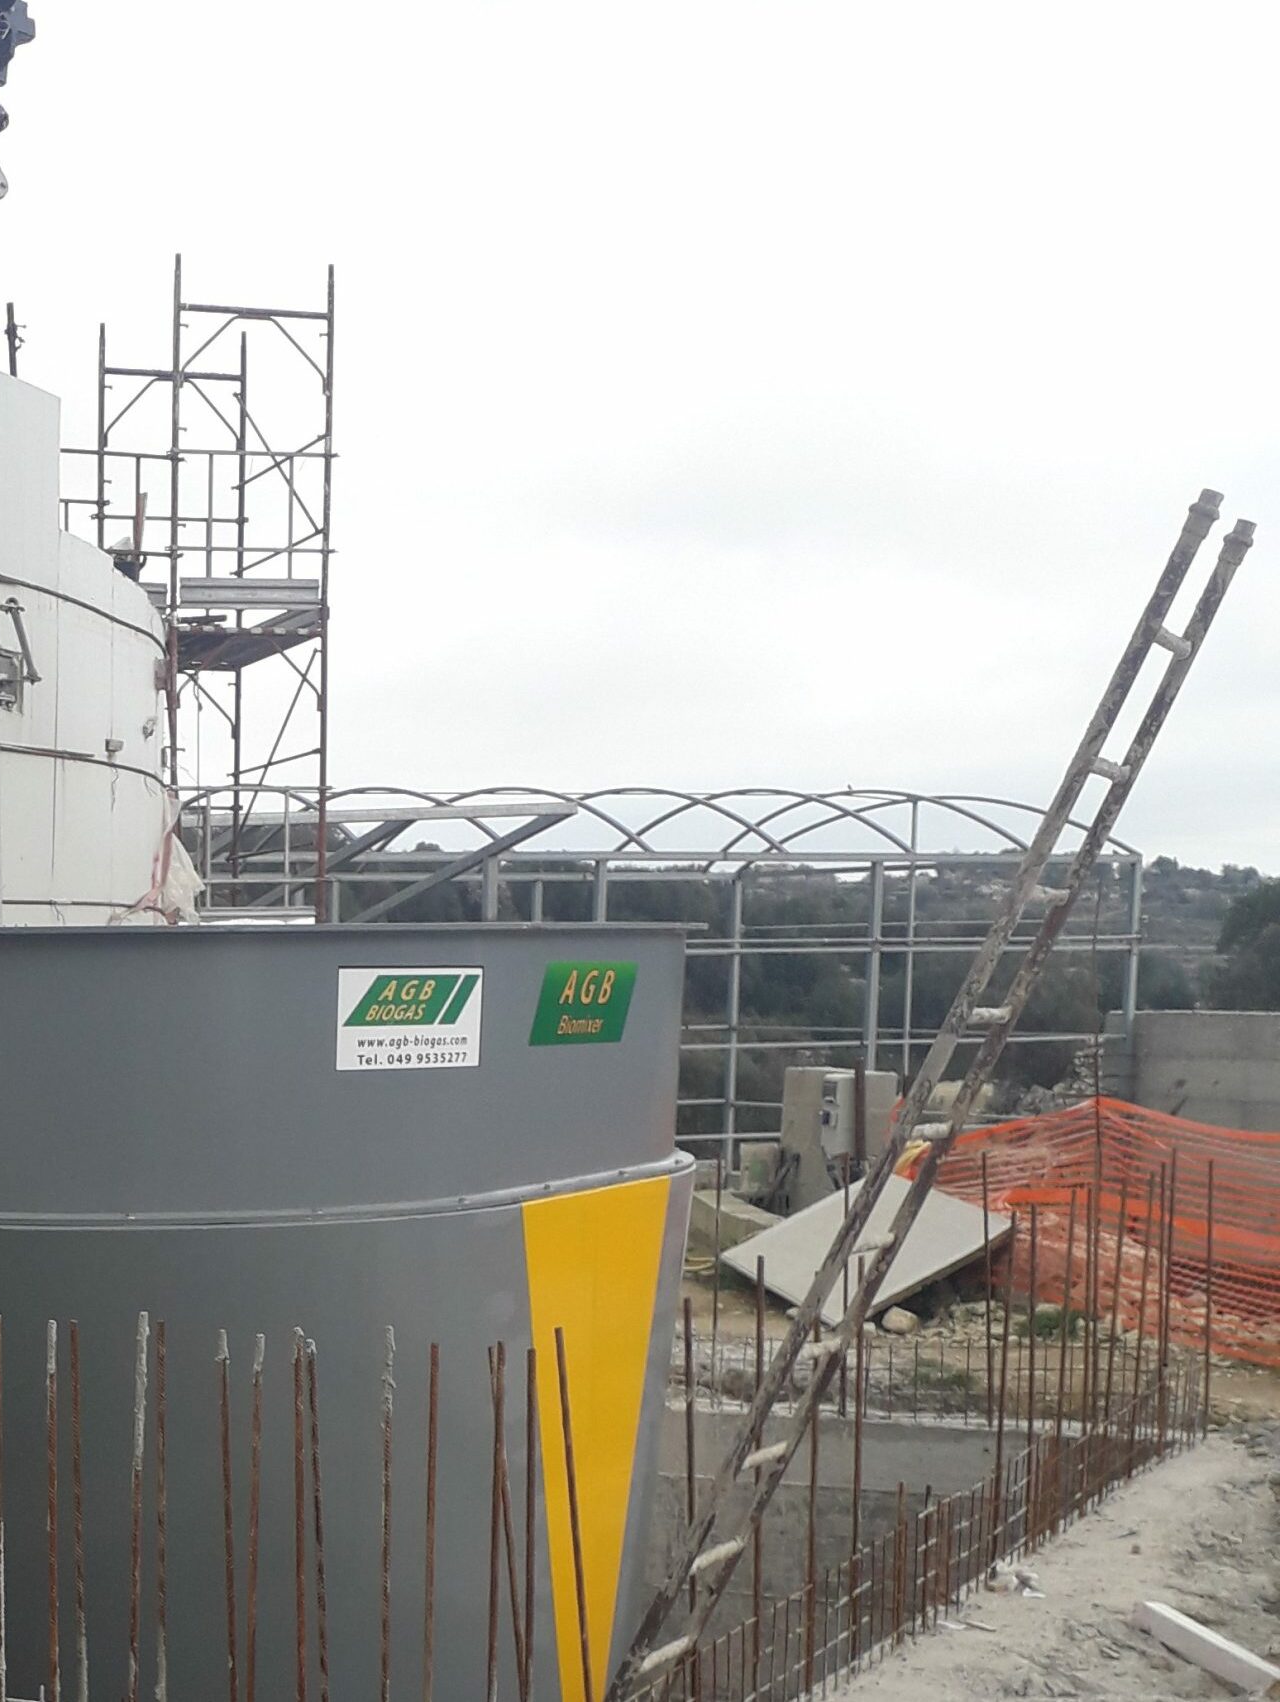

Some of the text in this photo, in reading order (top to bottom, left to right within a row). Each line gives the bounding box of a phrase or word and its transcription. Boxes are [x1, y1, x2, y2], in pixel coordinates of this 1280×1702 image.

[377, 979, 437, 1001] AGB
[558, 969, 616, 1005] AGB
[365, 1004, 426, 1021] BIOGAS
[357, 1034, 468, 1050] www.agb-biogas.com
[356, 1052, 467, 1066] Tel. 049 9535277
